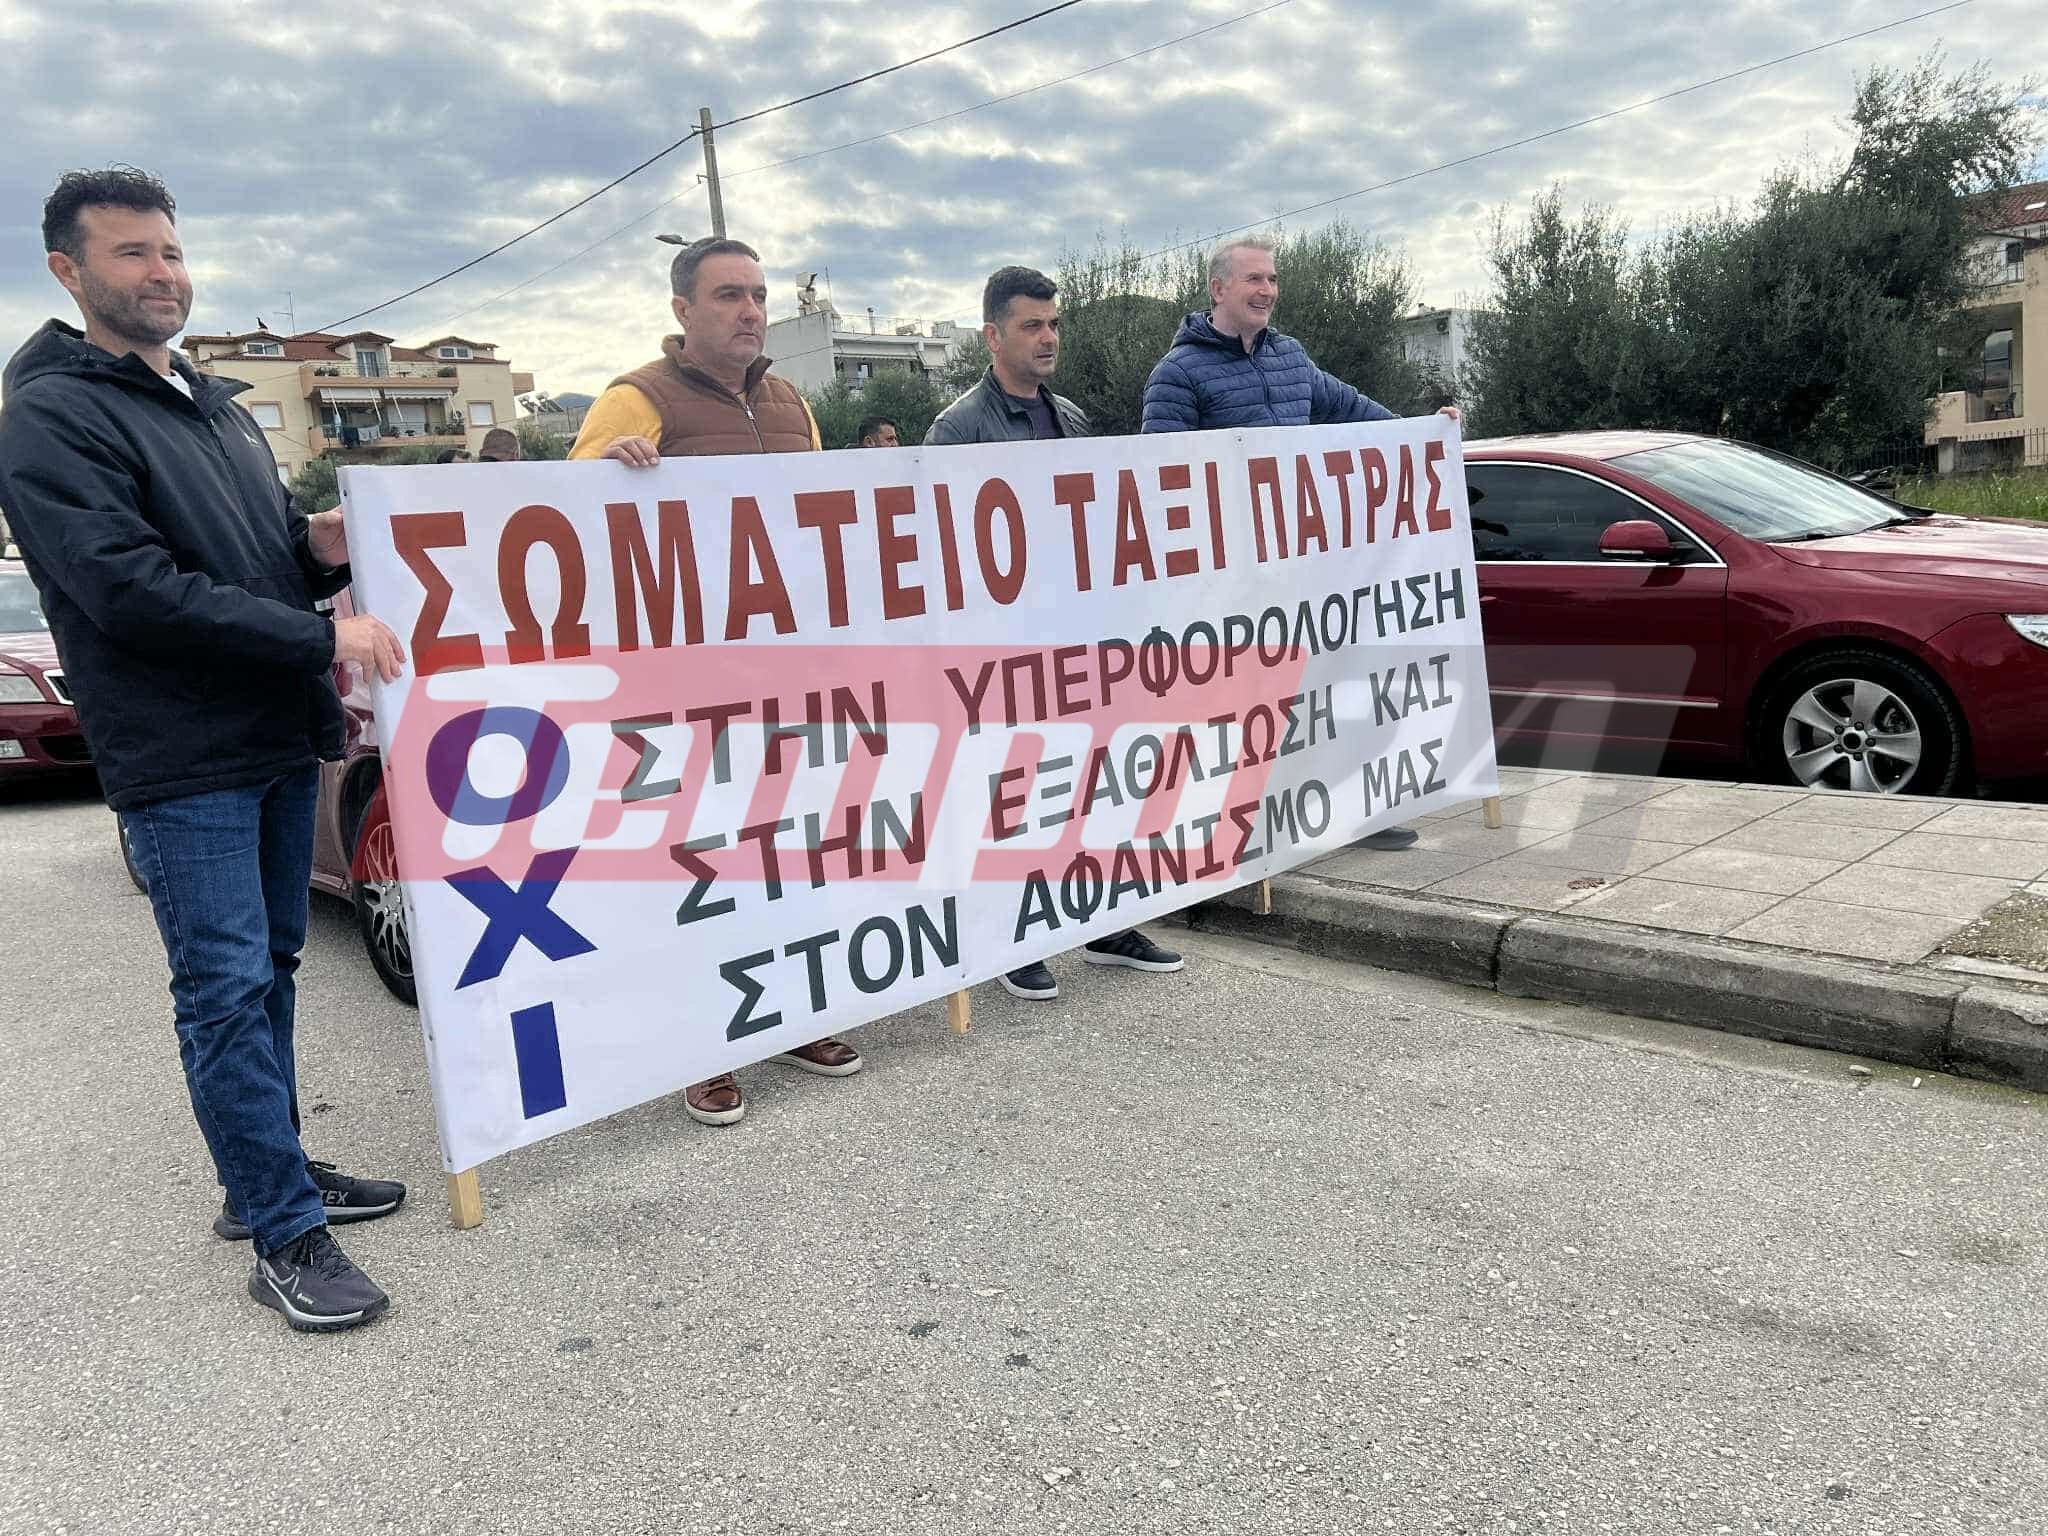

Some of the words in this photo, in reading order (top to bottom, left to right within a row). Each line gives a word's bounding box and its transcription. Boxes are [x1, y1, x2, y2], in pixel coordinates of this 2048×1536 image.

[389, 477, 1027, 677] ΣΩΜΑΤΕΙΟ
[1053, 461, 1226, 592] ΤΑΞΙ
[1247, 440, 1452, 564] ΠΑΤΡΑΣ
[610, 680, 889, 804] ΣΤΗΝ
[944, 568, 1466, 736] ΥΠΕΡΦΟΡΟΛΟΓΗΣΗ
[426, 705, 599, 1120] ΟΧΙ
[669, 791, 926, 926] ΣΤΗΝ
[988, 684, 1337, 843] ΕΞΑΘΛΙΩΣΗ
[1369, 653, 1454, 726] ΚΑΙ
[719, 896, 960, 1041] ΣΤΟΝ
[1013, 779, 1331, 943] ΑΦΑΝΙΣΜΟ
[1363, 738, 1447, 817] ΜΑΣ
